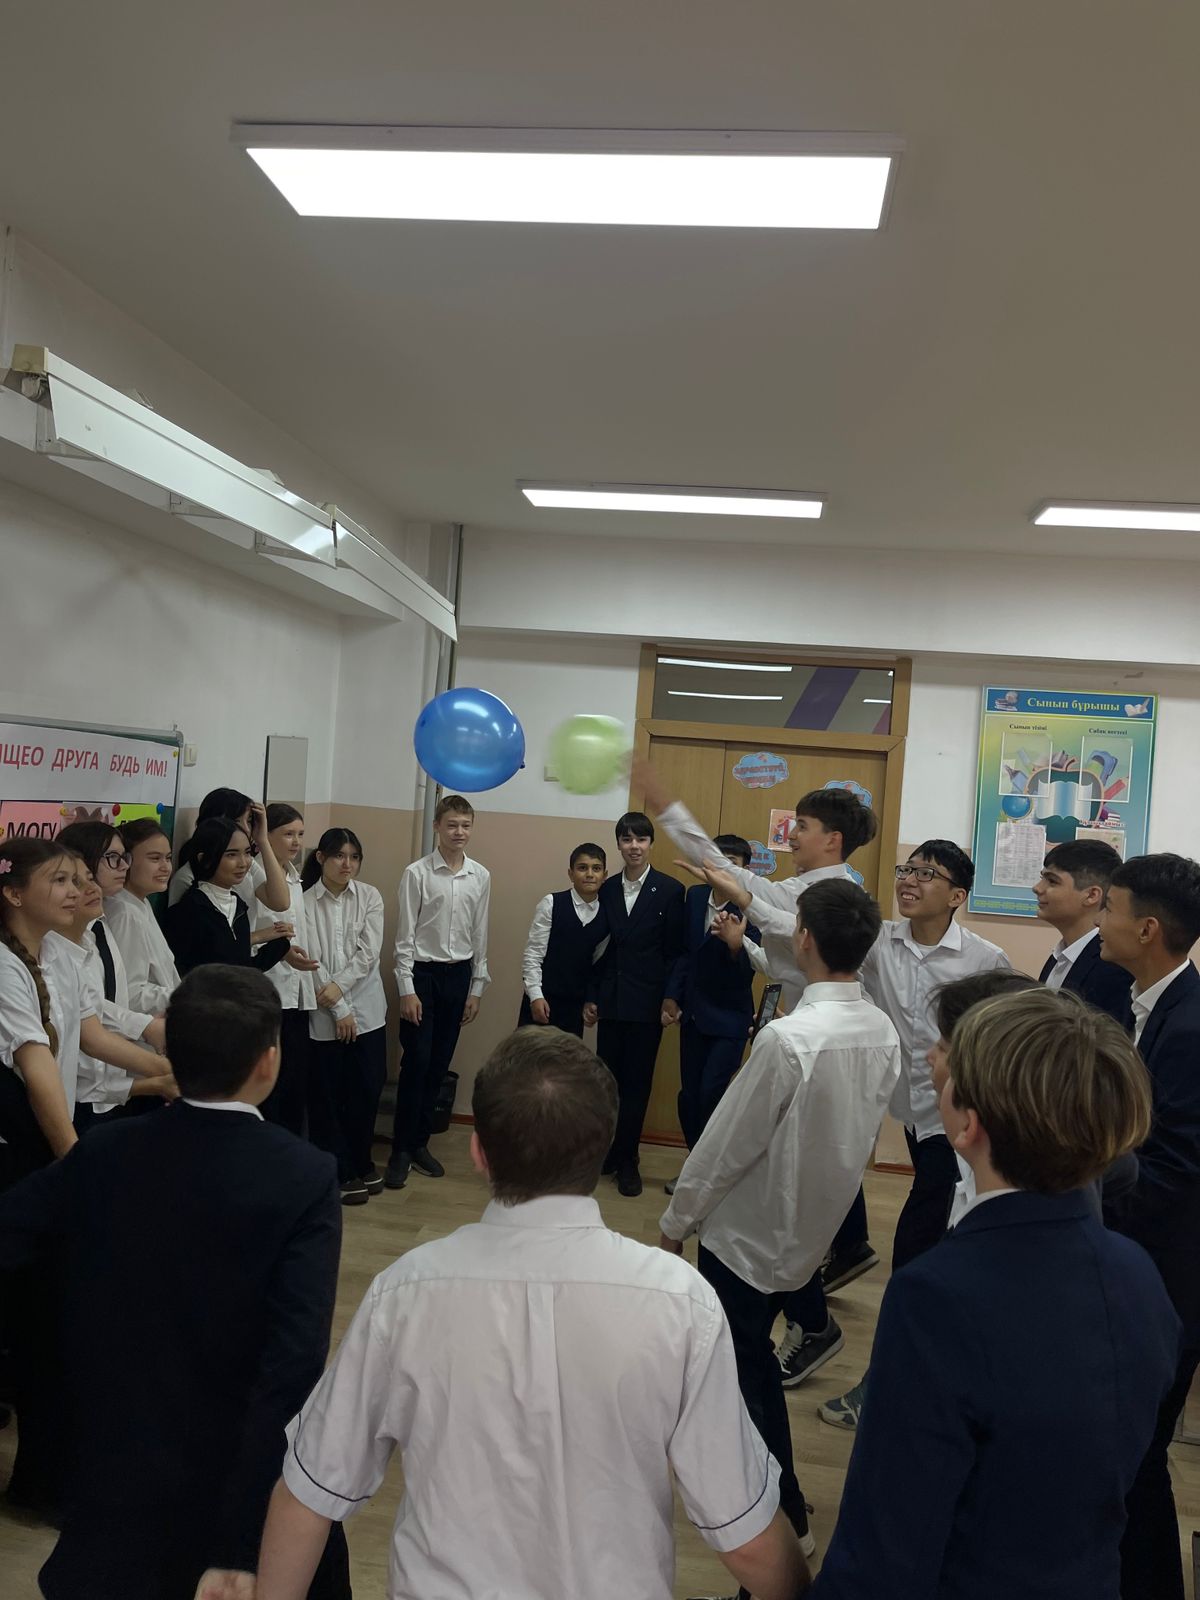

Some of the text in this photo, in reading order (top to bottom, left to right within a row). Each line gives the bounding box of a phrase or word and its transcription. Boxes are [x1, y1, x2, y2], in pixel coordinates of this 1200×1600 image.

[1027, 697, 1068, 709] Сынып
[51, 748, 99, 772] ДРУГА
[110, 754, 140, 777] БУДЬ
[145, 758, 168, 778] ИМ!
[7, 821, 57, 841] МОГУ
